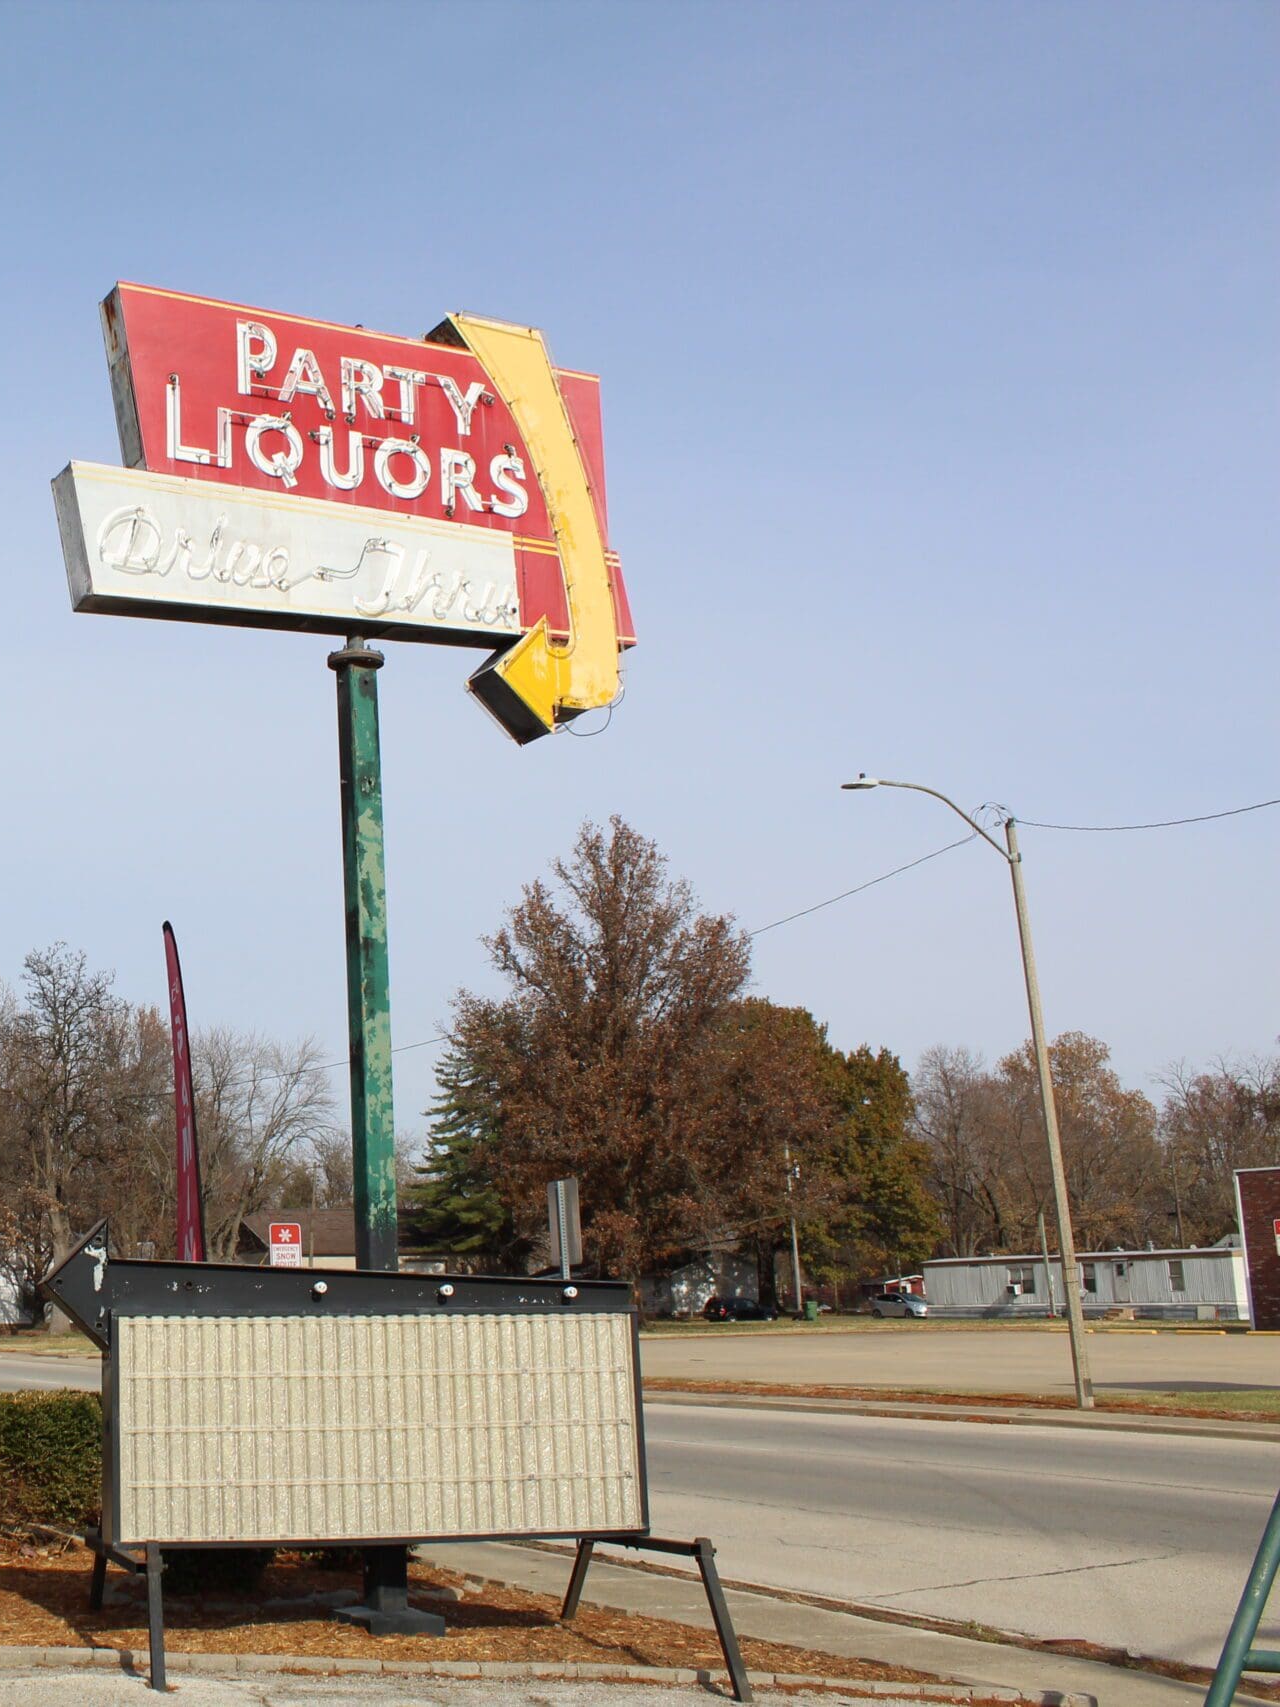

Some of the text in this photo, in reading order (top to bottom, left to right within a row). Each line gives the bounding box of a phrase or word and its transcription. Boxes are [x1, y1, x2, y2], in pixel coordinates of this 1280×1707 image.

[237, 320, 487, 435] PARTY
[166, 380, 528, 518] LIQUORS
[98, 504, 517, 629] Drive Thru
[275, 1252, 296, 1260] SNOW
